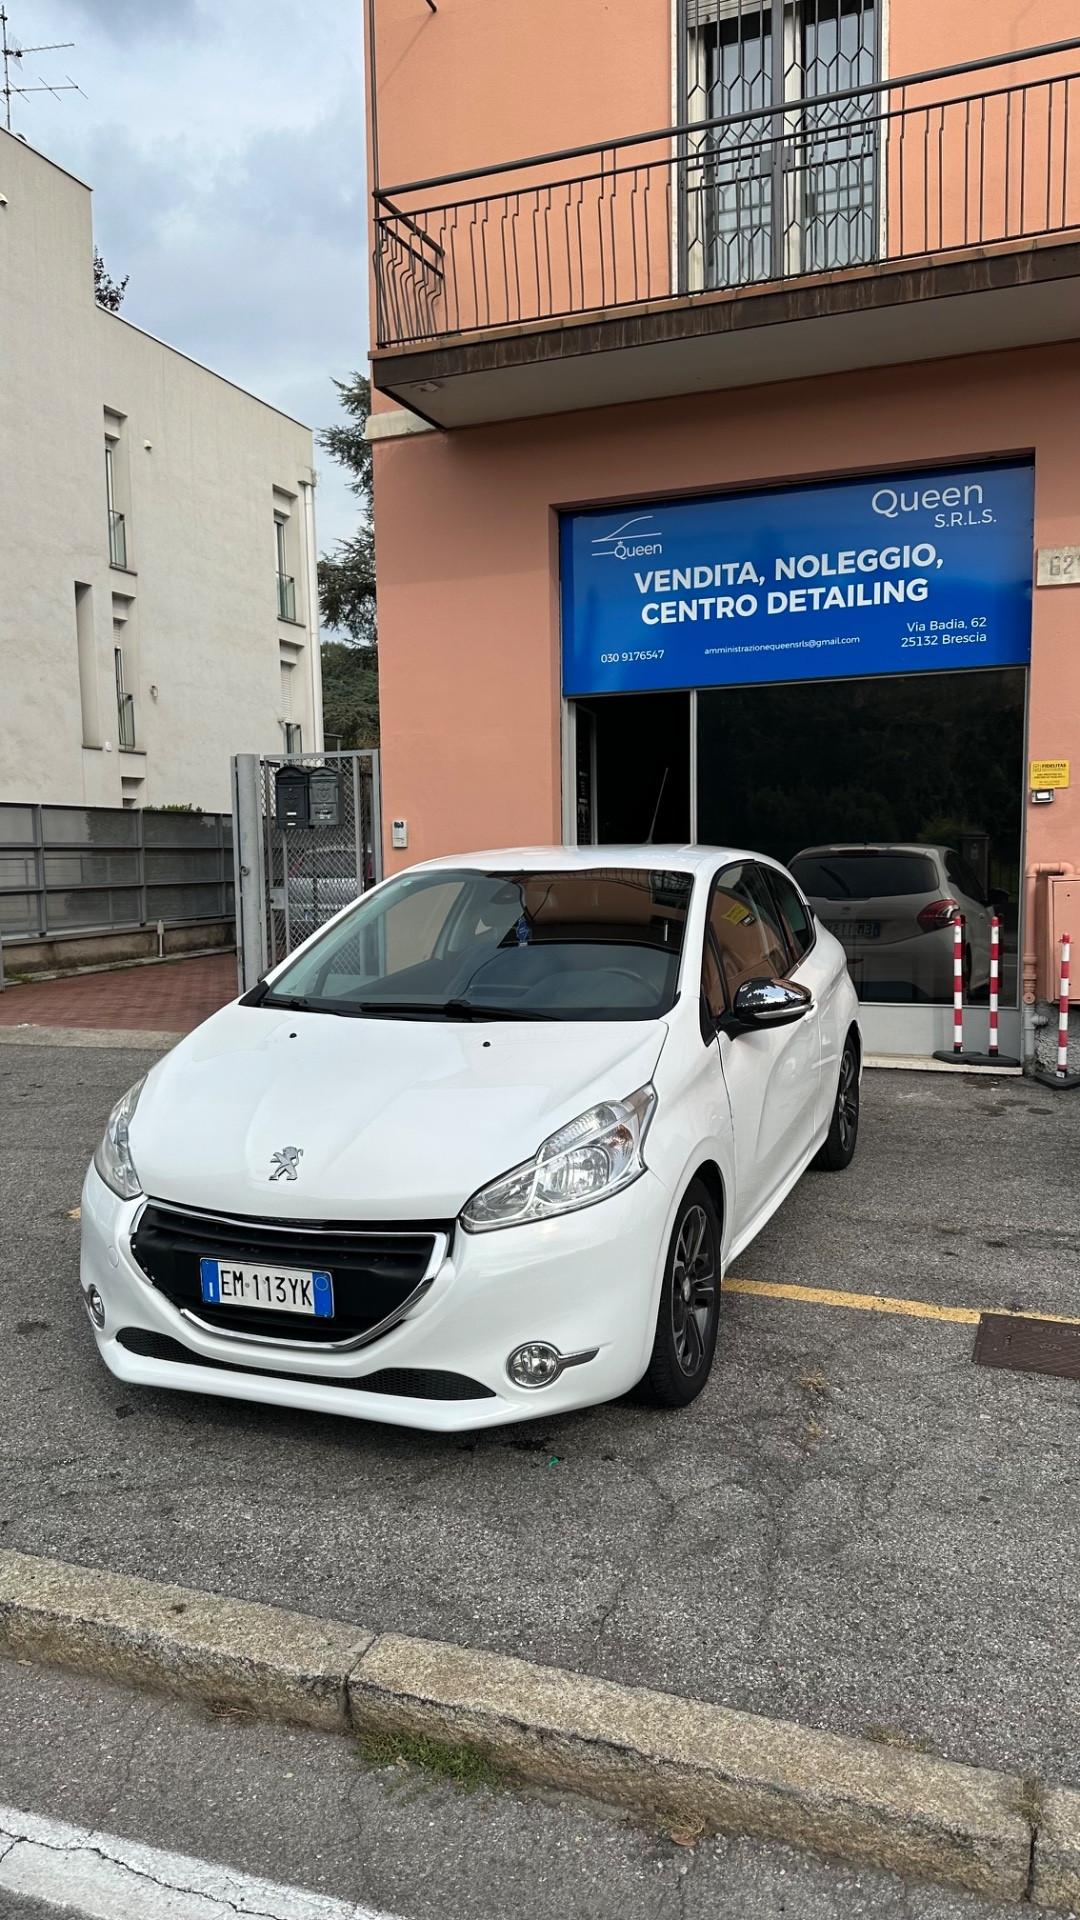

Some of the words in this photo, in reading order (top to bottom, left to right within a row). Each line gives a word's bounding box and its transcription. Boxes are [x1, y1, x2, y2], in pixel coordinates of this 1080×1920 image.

[871, 484, 984, 519] Queen
[933, 508, 997, 529] S.R.L.S.
[613, 543, 662, 560] Queen
[633, 561, 766, 594] VENDITA,
[775, 542, 944, 581] NOLEGGIO,
[641, 593, 758, 625] CENTRO
[767, 578, 929, 614] DETAILING
[907, 621, 927, 633] Via
[929, 618, 968, 633] Badia,
[970, 616, 988, 629] 62
[704, 635, 860, 655] amministrazionequeensrls@gmail.com
[901, 634, 939, 649] 25132
[942, 632, 987, 646] Brescia
[600, 653, 620, 664] 030
[621, 649, 665, 663] 9176547
